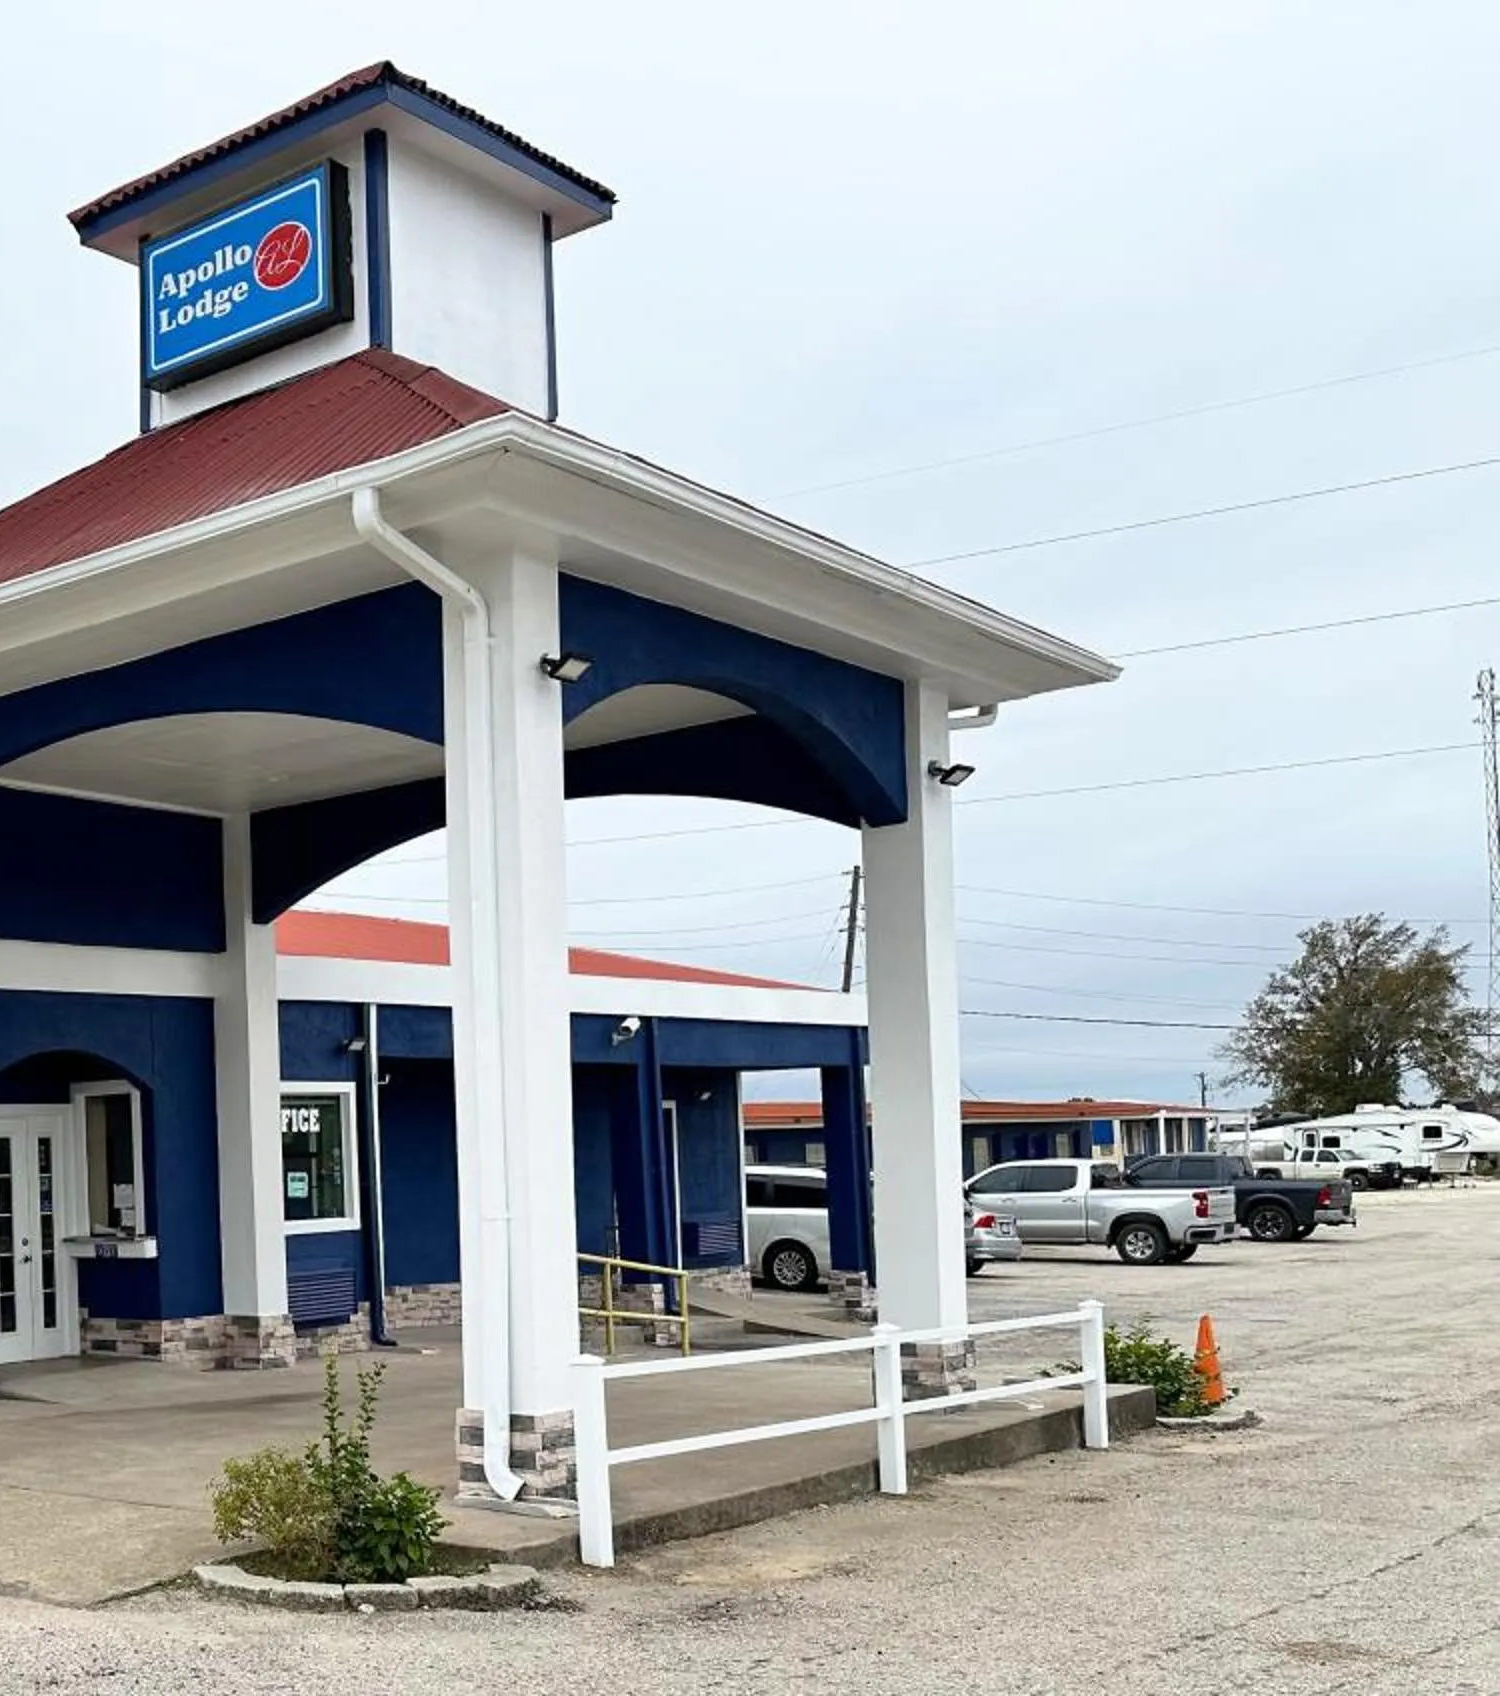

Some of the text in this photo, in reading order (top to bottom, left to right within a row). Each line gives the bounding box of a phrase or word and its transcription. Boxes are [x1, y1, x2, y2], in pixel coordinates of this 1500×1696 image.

[158, 244, 252, 300] Apollo
[158, 281, 249, 335] Lodge
[281, 1108, 321, 1133] FICE
